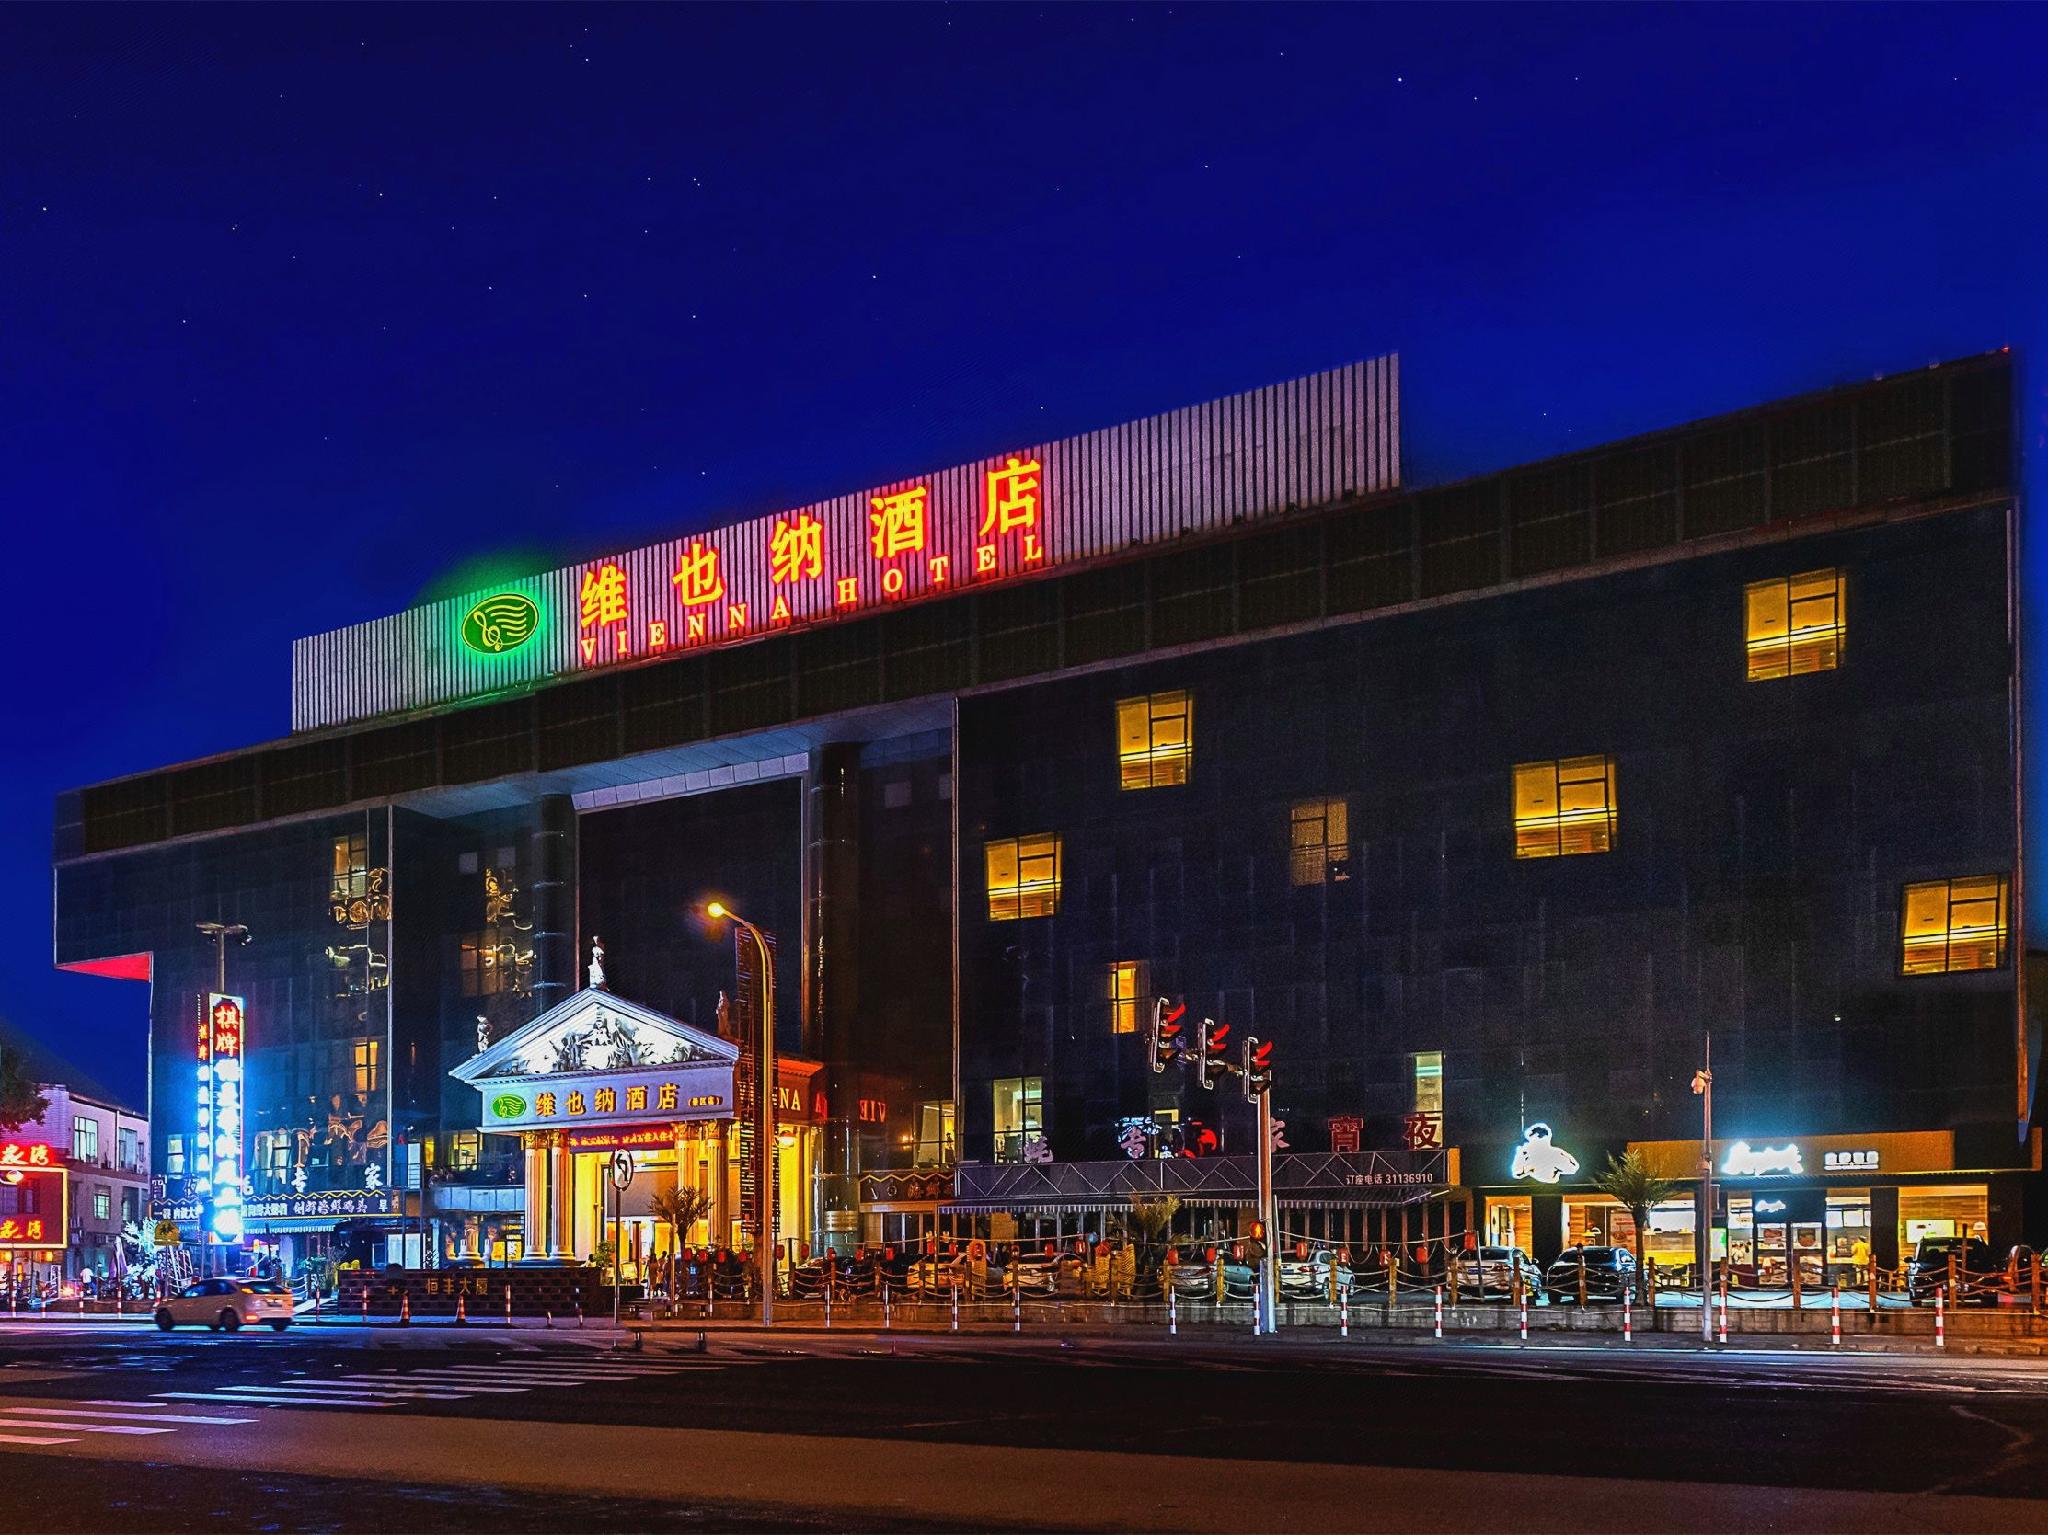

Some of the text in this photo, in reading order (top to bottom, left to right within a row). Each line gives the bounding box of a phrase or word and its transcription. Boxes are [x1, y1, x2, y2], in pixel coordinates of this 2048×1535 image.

[580, 457, 1042, 629] 维也纳酒店
[581, 535, 1043, 661] VIENNA HOTEL
[214, 1006, 239, 1058] 棋牌
[535, 1083, 681, 1117] 维也纳酒店
[1346, 1172, 1433, 1185] 订座电话 31136910
[425, 1276, 489, 1296] 恒丰大厦
